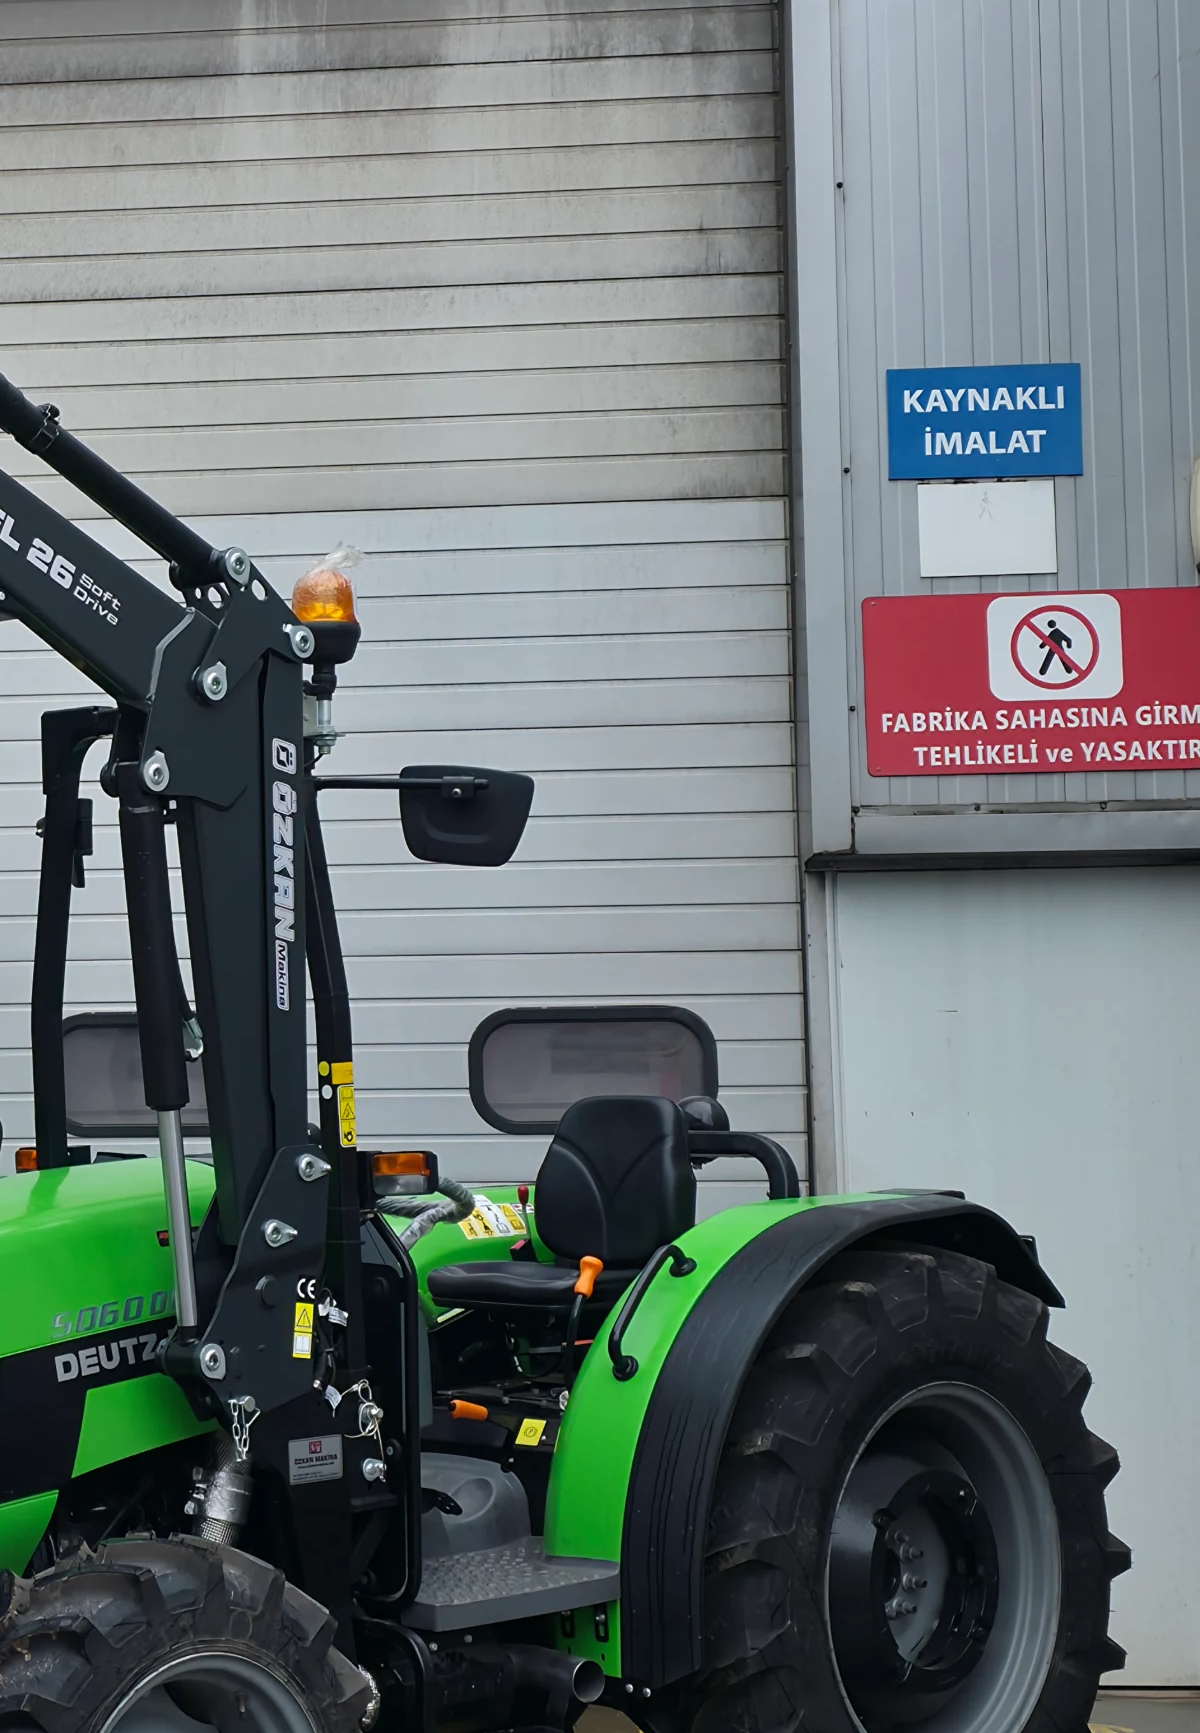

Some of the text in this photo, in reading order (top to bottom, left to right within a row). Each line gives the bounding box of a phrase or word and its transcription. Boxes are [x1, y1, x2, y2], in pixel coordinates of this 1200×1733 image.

[903, 385, 1065, 414] KAYNAKLI
[924, 426, 1047, 456] İMALAT
[26, 537, 77, 590] 26
[73, 586, 119, 626] Drive
[78, 573, 122, 611] Soft
[881, 700, 1200, 733] FABRİKA SAHASINA GİRM
[914, 739, 1039, 767] TEHLİKELİ
[1046, 748, 1073, 763] ve
[272, 780, 297, 942] ÖZKAN
[54, 1333, 157, 1383] DEUTZ
